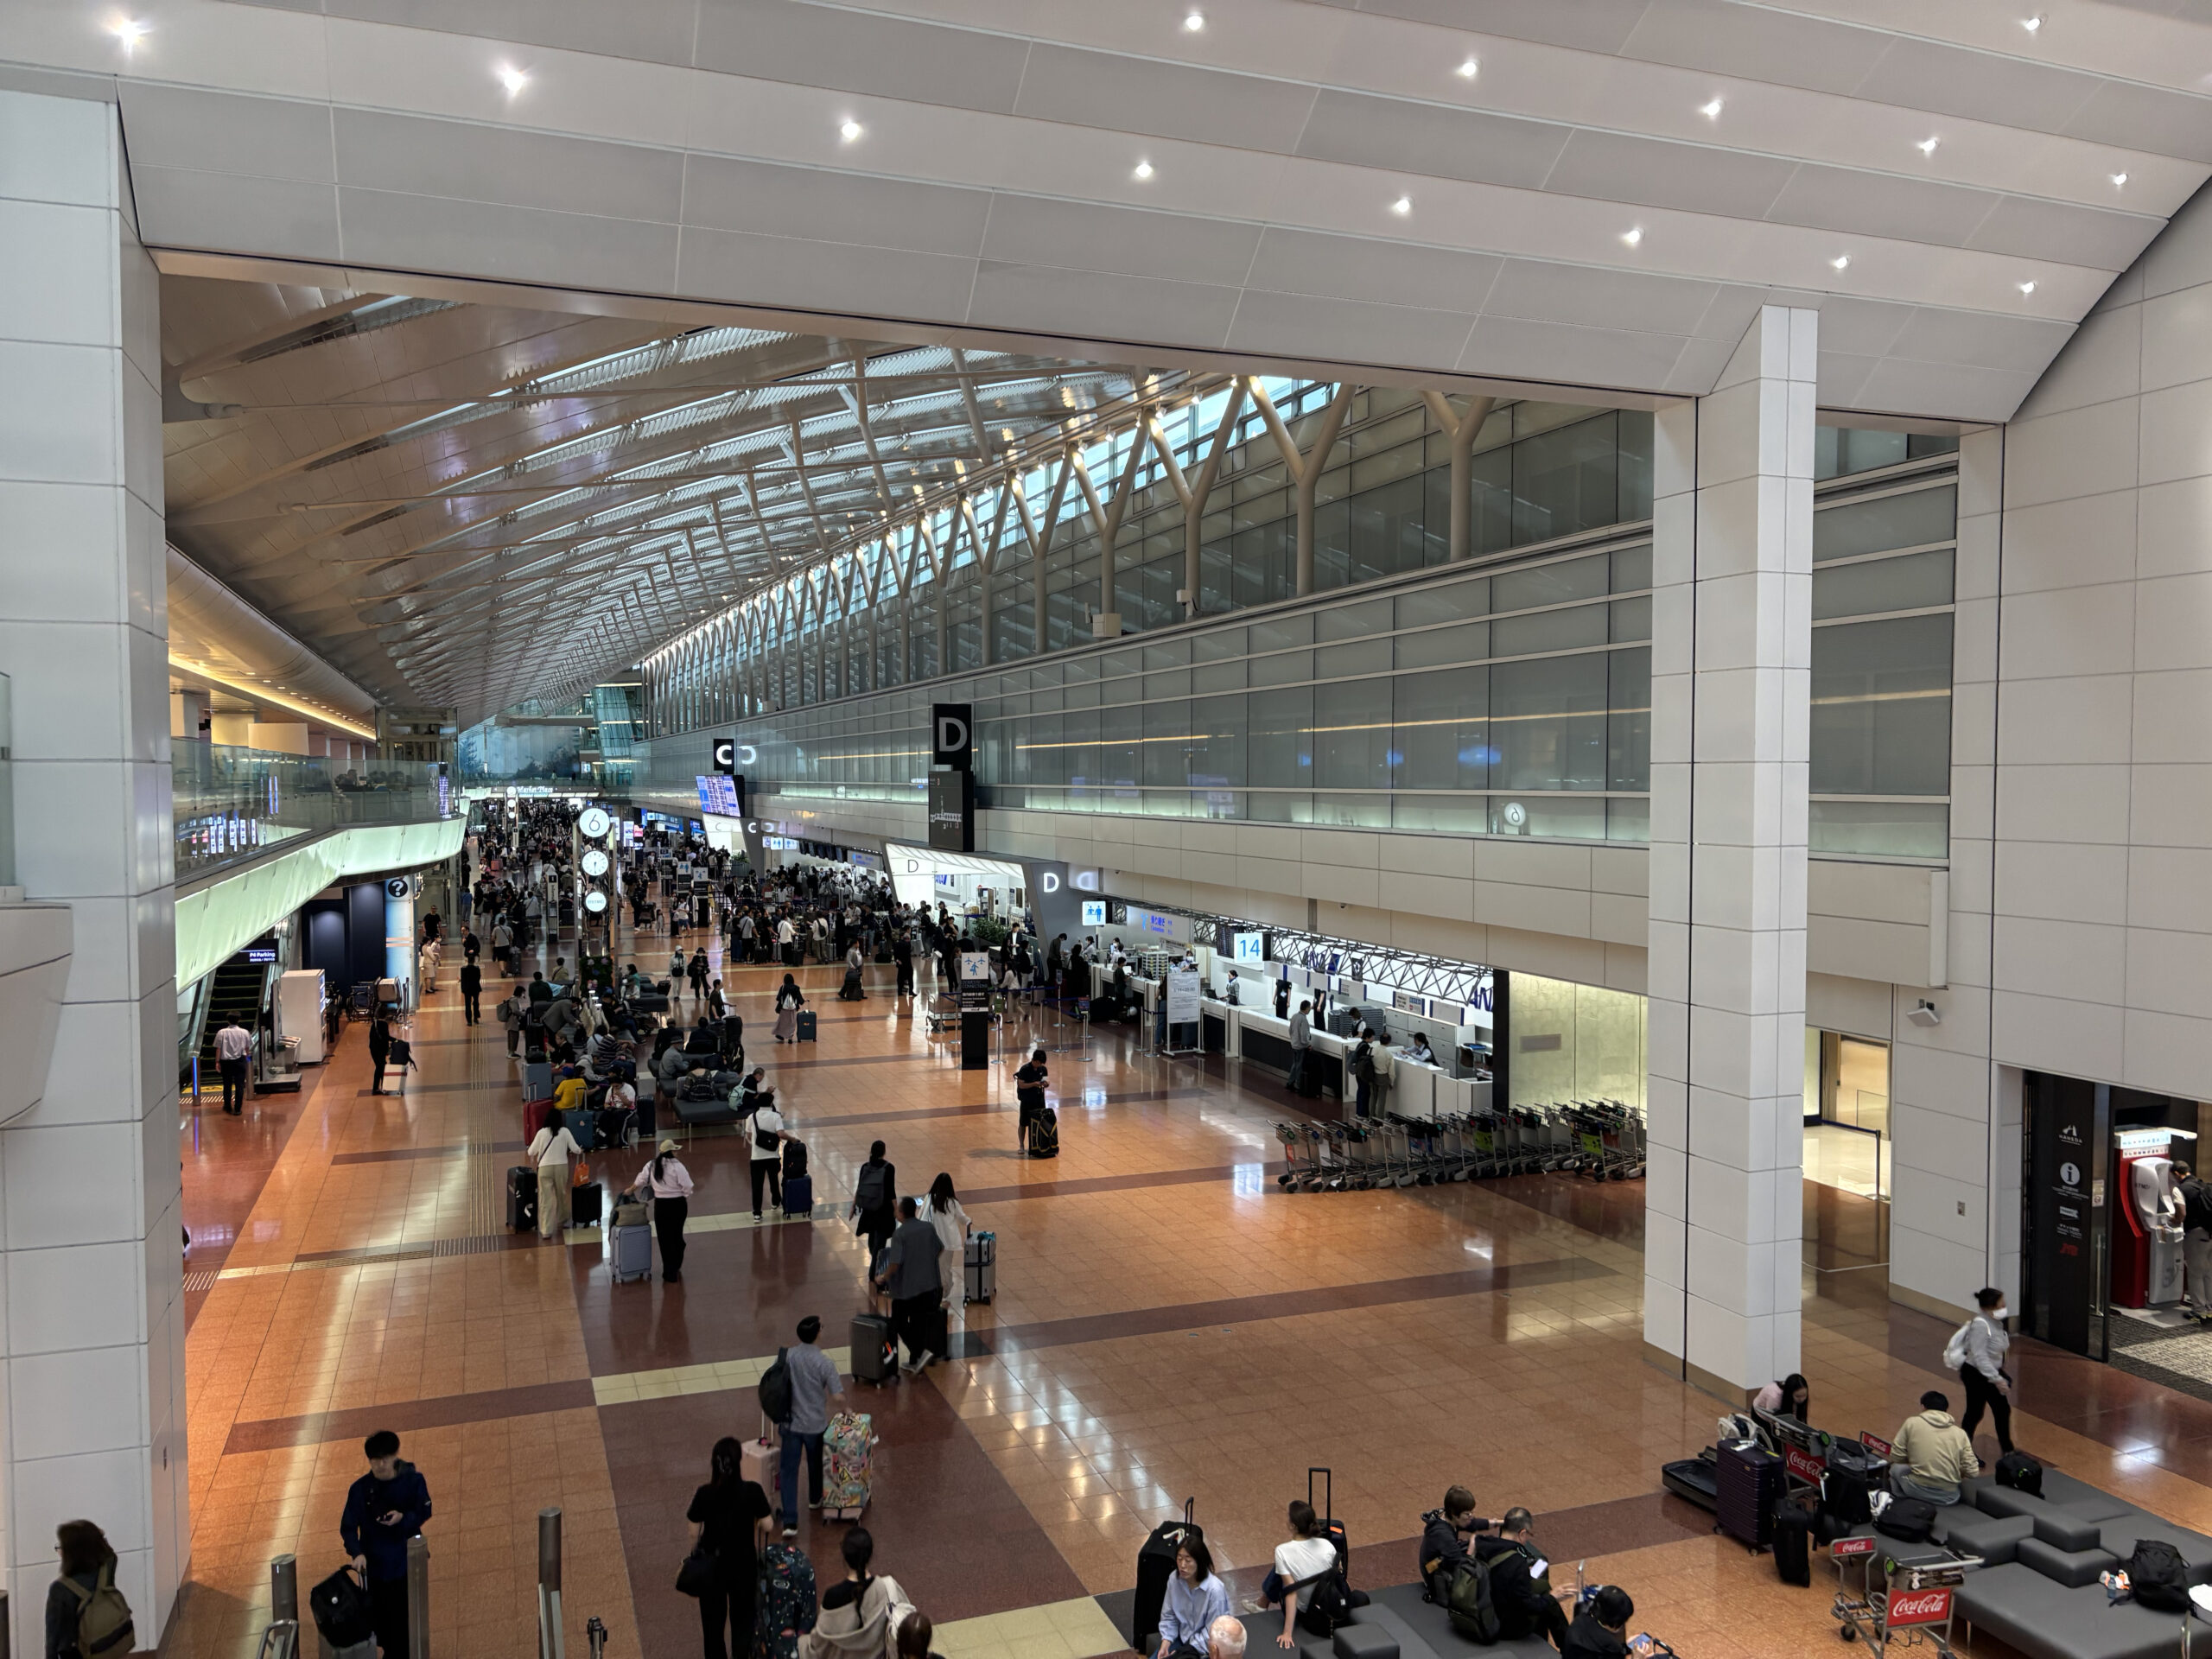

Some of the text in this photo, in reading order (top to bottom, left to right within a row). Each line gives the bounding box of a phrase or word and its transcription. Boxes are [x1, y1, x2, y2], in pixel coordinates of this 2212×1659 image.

[938, 716, 968, 752] D
[715, 744, 733, 765] C
[588, 813, 601, 832] 6
[747, 822, 757, 834] C
[907, 859, 919, 874] D
[1043, 872, 1059, 893] D
[1239, 938, 1261, 957] 14
[1469, 987, 1493, 1012] AN
